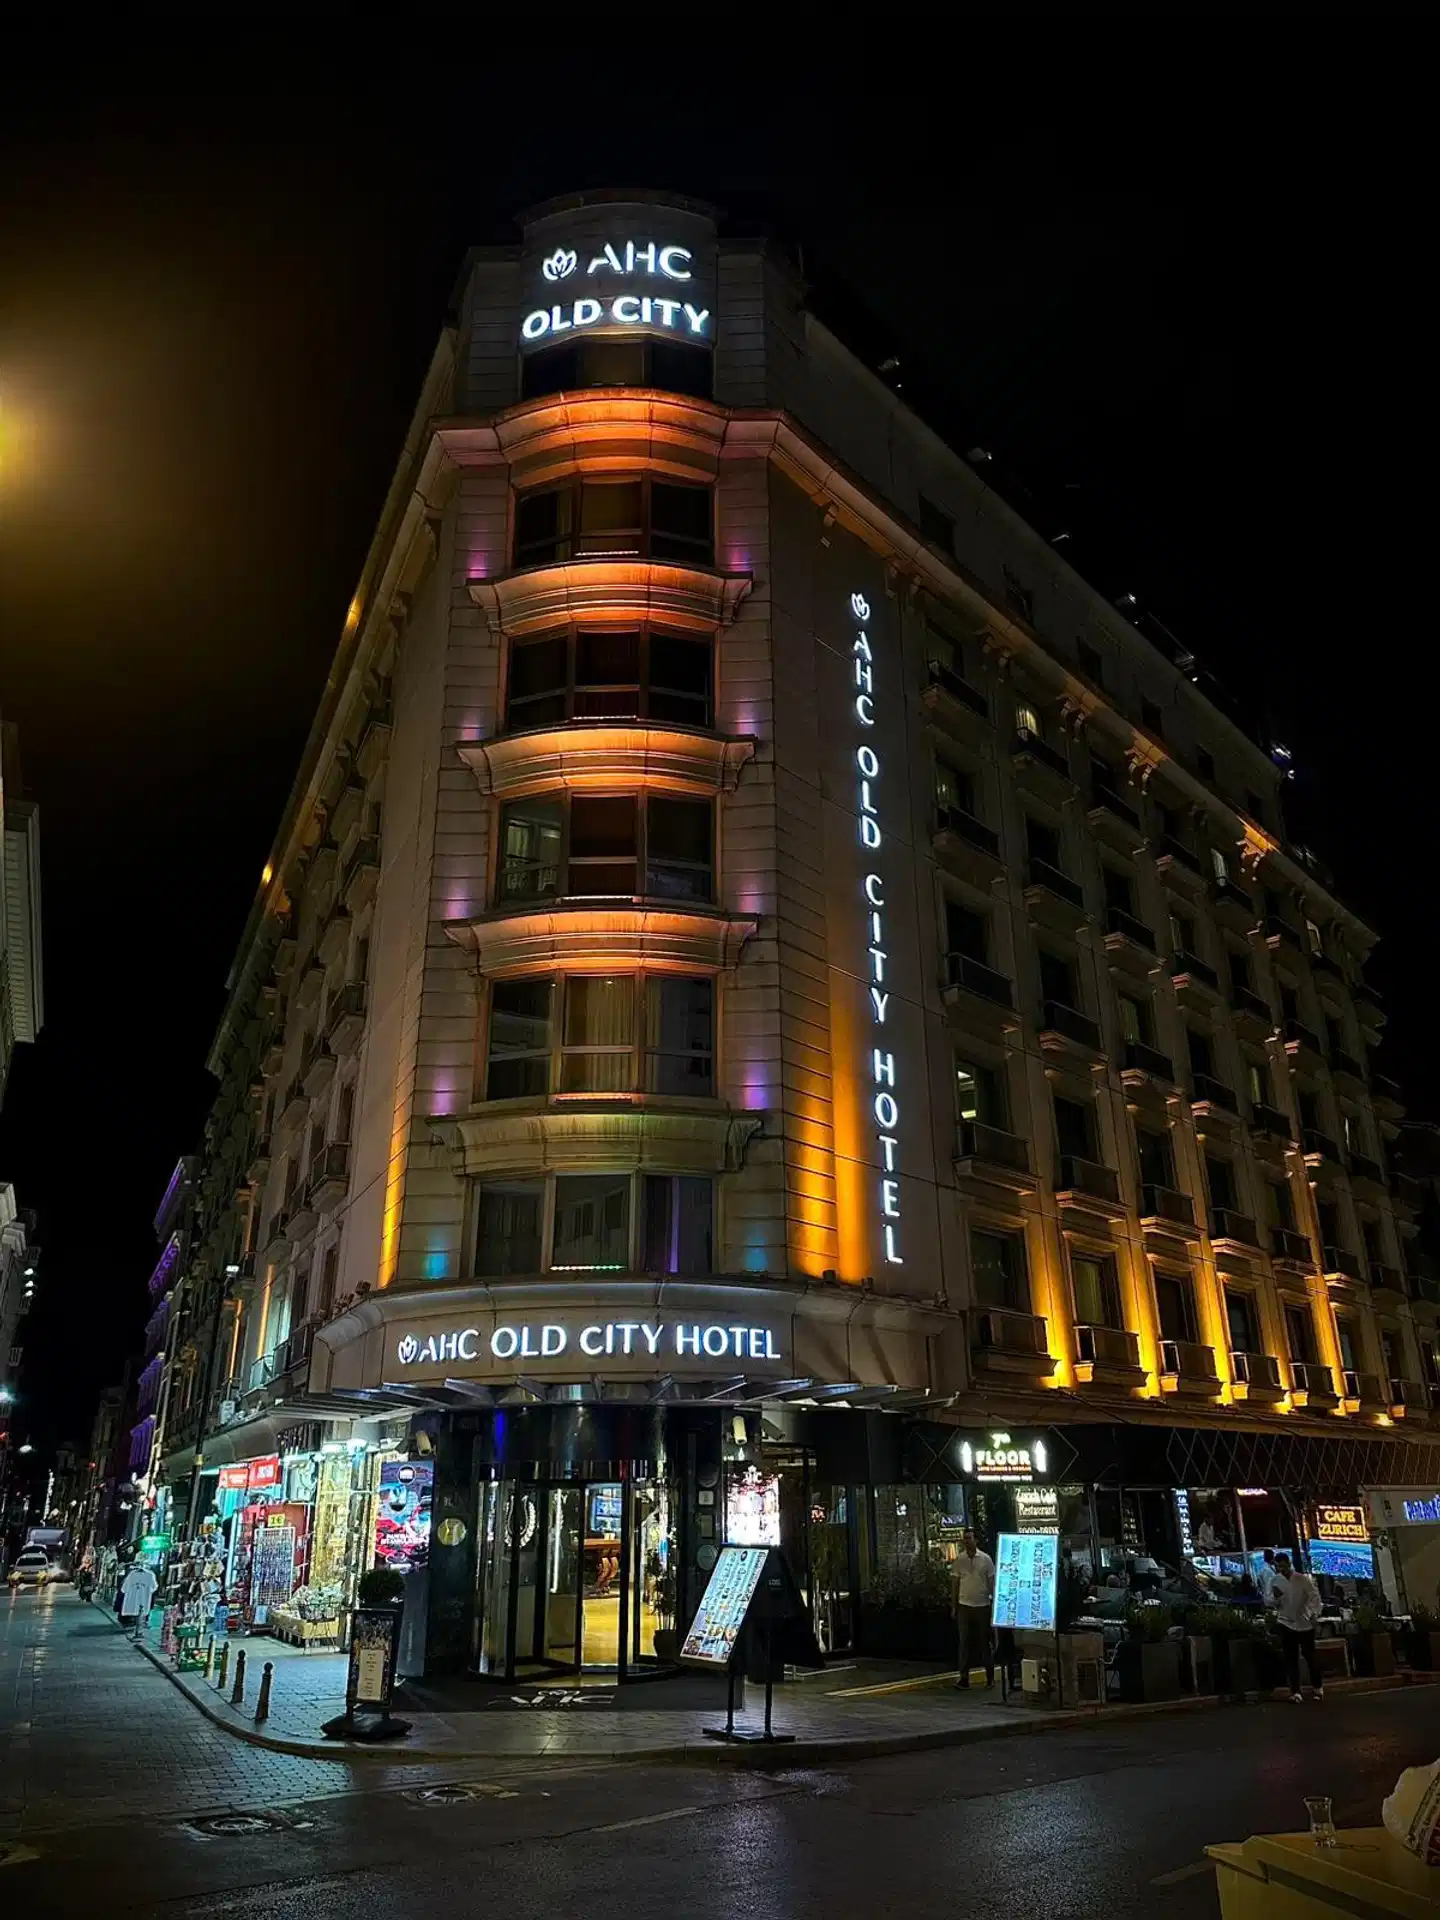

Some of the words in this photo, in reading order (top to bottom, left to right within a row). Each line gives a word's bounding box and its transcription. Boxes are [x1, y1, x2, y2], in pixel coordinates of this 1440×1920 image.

[587, 241, 692, 280] AHC
[522, 298, 603, 339] OLD
[611, 296, 710, 334] CITY
[852, 631, 875, 726] AHC
[857, 746, 882, 849] OLD
[865, 874, 889, 1023] CITY
[874, 1048, 904, 1265] HOTEL
[419, 1328, 479, 1362] AHC
[490, 1325, 567, 1358] OLD
[579, 1323, 663, 1356] CITY
[676, 1325, 781, 1359] HOTEL
[975, 1450, 1031, 1465] FLOOR
[1324, 1510, 1355, 1523] CAFE
